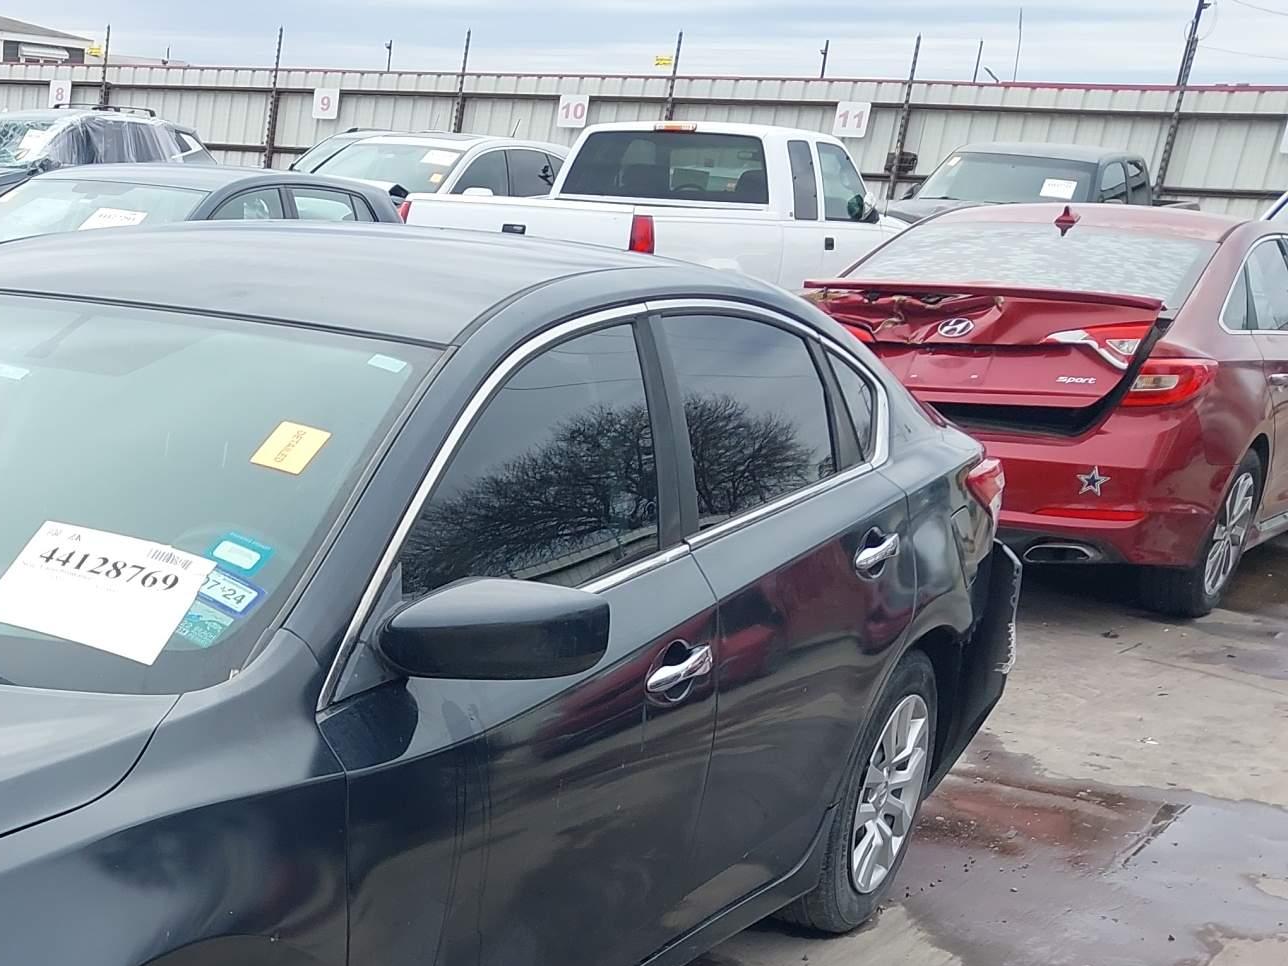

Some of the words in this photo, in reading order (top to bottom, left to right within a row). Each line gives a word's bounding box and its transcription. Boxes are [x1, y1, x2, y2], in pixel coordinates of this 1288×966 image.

[55, 87, 65, 102] 8
[320, 95, 331, 112] 9
[561, 102, 586, 120] 10
[838, 110, 865, 129] 11
[39, 546, 180, 591] 44128769
